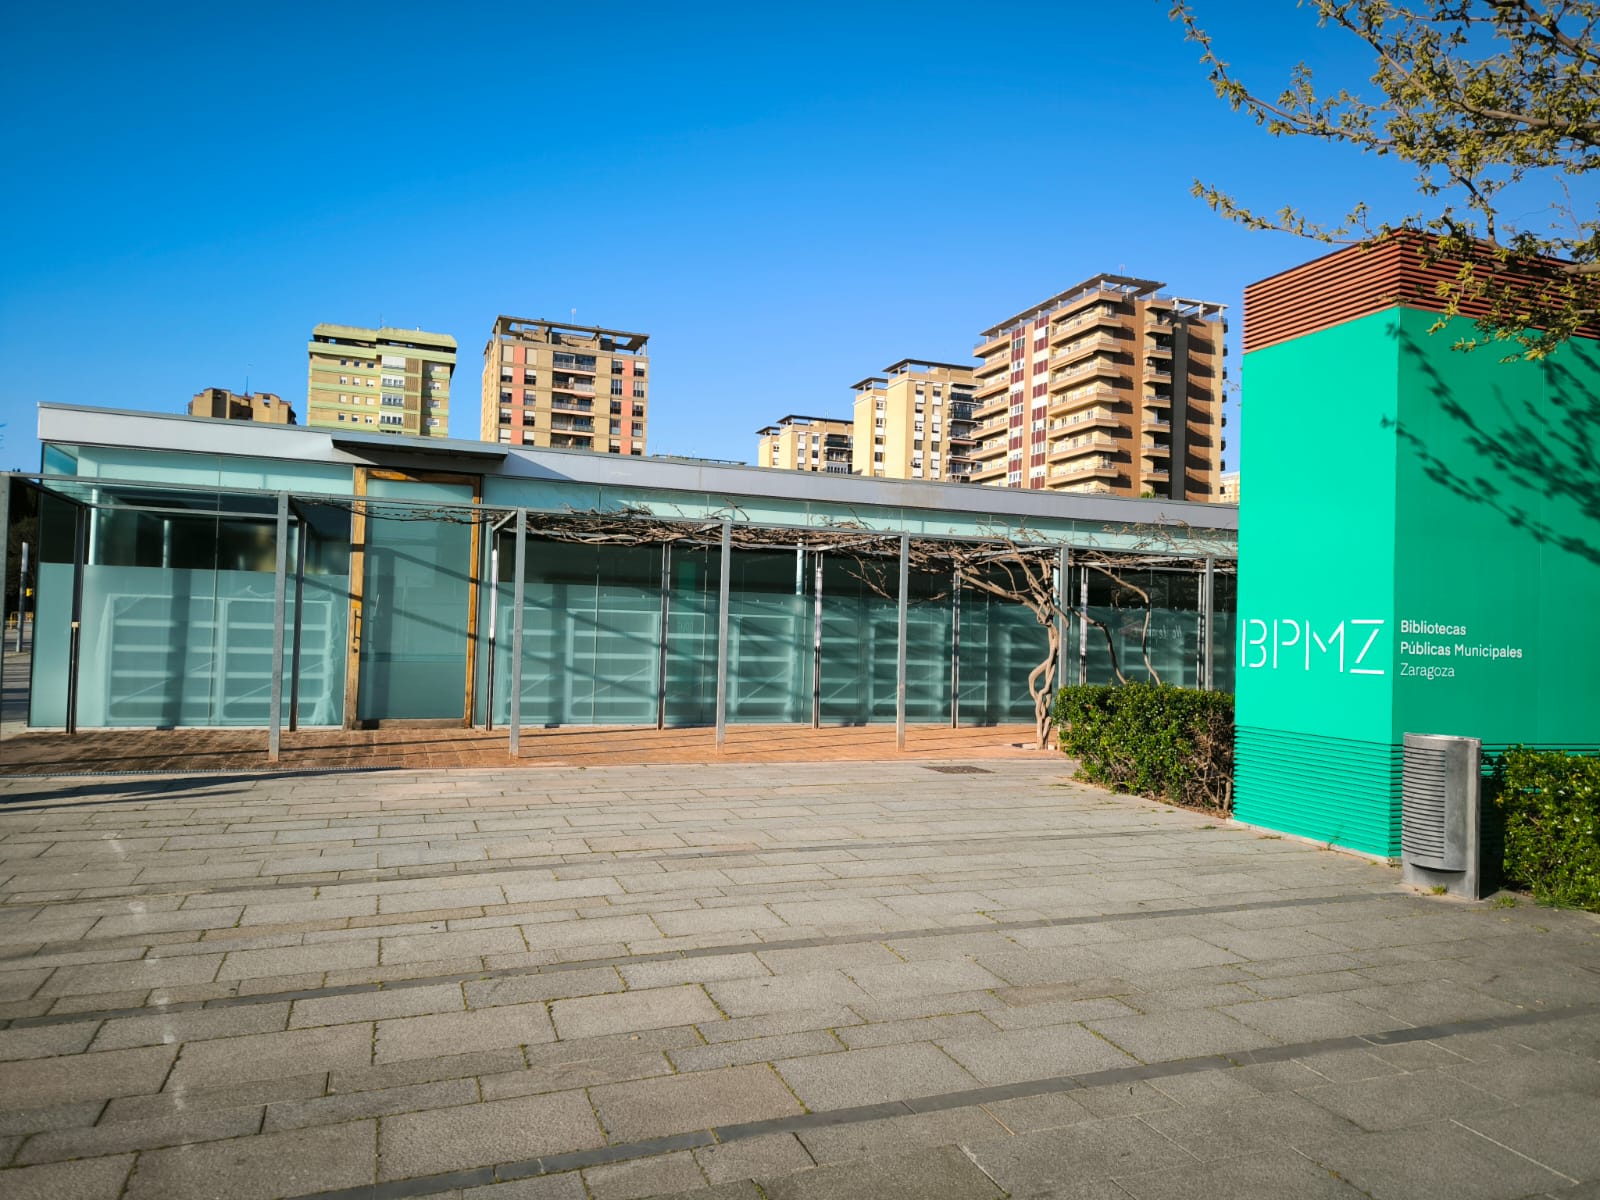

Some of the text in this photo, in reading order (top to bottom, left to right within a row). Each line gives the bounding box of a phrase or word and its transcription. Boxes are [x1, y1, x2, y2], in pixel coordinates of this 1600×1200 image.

[1400, 619, 1467, 636] Bibliotecas
[1241, 619, 1385, 675] BPMZ
[1400, 641, 1523, 659] Públicas Municipales
[1400, 662, 1455, 680] Zaragoza
